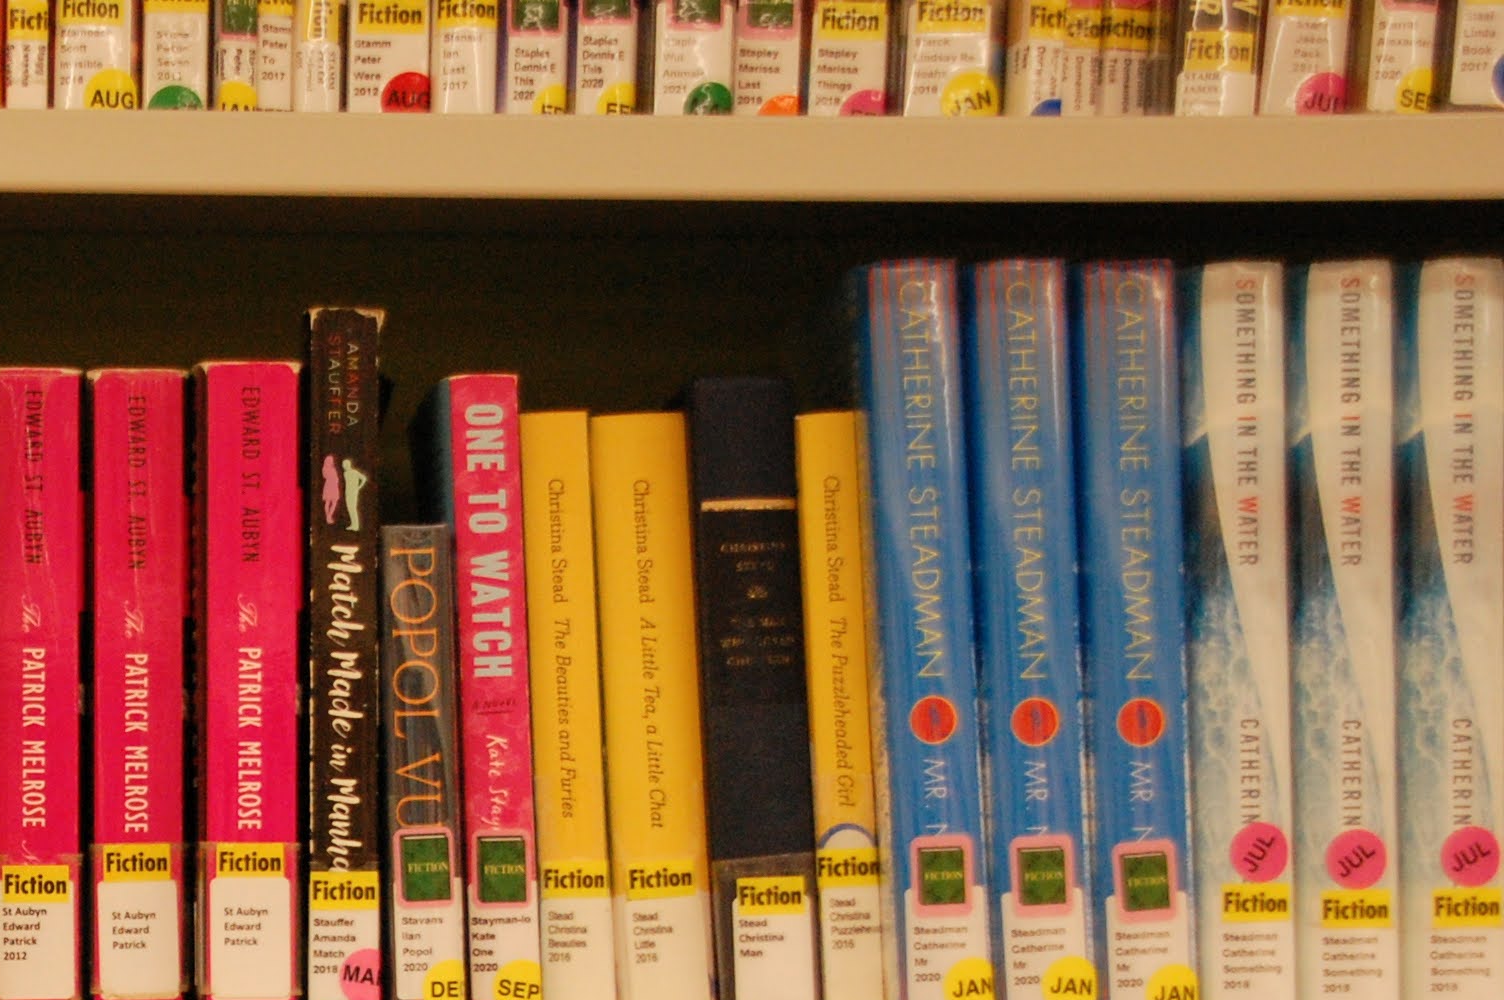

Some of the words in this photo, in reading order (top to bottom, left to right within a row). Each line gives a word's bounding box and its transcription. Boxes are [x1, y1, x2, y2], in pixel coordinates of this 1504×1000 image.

[359, 4, 422, 24] Fiction
[821, 8, 878, 31] Fiction
[355, 40, 391, 48] Stamm
[355, 56, 381, 64] Peter
[91, 90, 134, 109] AUG
[1236, 279, 1257, 405] SOMETHING
[345, 343, 359, 428] AMANDA
[1006, 281, 1041, 471] CATHERINE
[241, 387, 261, 460] EDWARD
[465, 403, 506, 472] ONE
[1237, 415, 1257, 437] IN
[241, 472, 260, 495] ST.
[1237, 448, 1257, 486] THE
[468, 490, 508, 535] TO
[548, 479, 564, 553] Christina
[1237, 496, 1258, 566] WATER
[242, 507, 261, 563] AUBYN
[326, 544, 365, 645] Match
[551, 559, 568, 603] Stead
[1013, 489, 1047, 680] STEADMAN
[237, 593, 258, 633] The
[470, 550, 512, 679] WATCH
[390, 546, 441, 739] POPOL
[554, 618, 571, 648] The
[238, 647, 262, 727] PATRICK
[327, 650, 363, 738] Made
[556, 655, 572, 724] Beauties
[329, 744, 354, 772] in
[558, 728, 575, 762] and
[237, 741, 262, 830] MELROSE
[561, 766, 576, 819] Furies
[1245, 835, 1275, 872] JUL
[313, 881, 376, 900] Fiction
[3, 937, 37, 946] Patrick
[3, 952, 27, 960] 2012
[402, 947, 432, 958] Popol
[472, 932, 496, 941] Kate
[740, 933, 784, 942] Christina
[498, 979, 540, 1000] SEP
[1050, 977, 1092, 996] JAN
